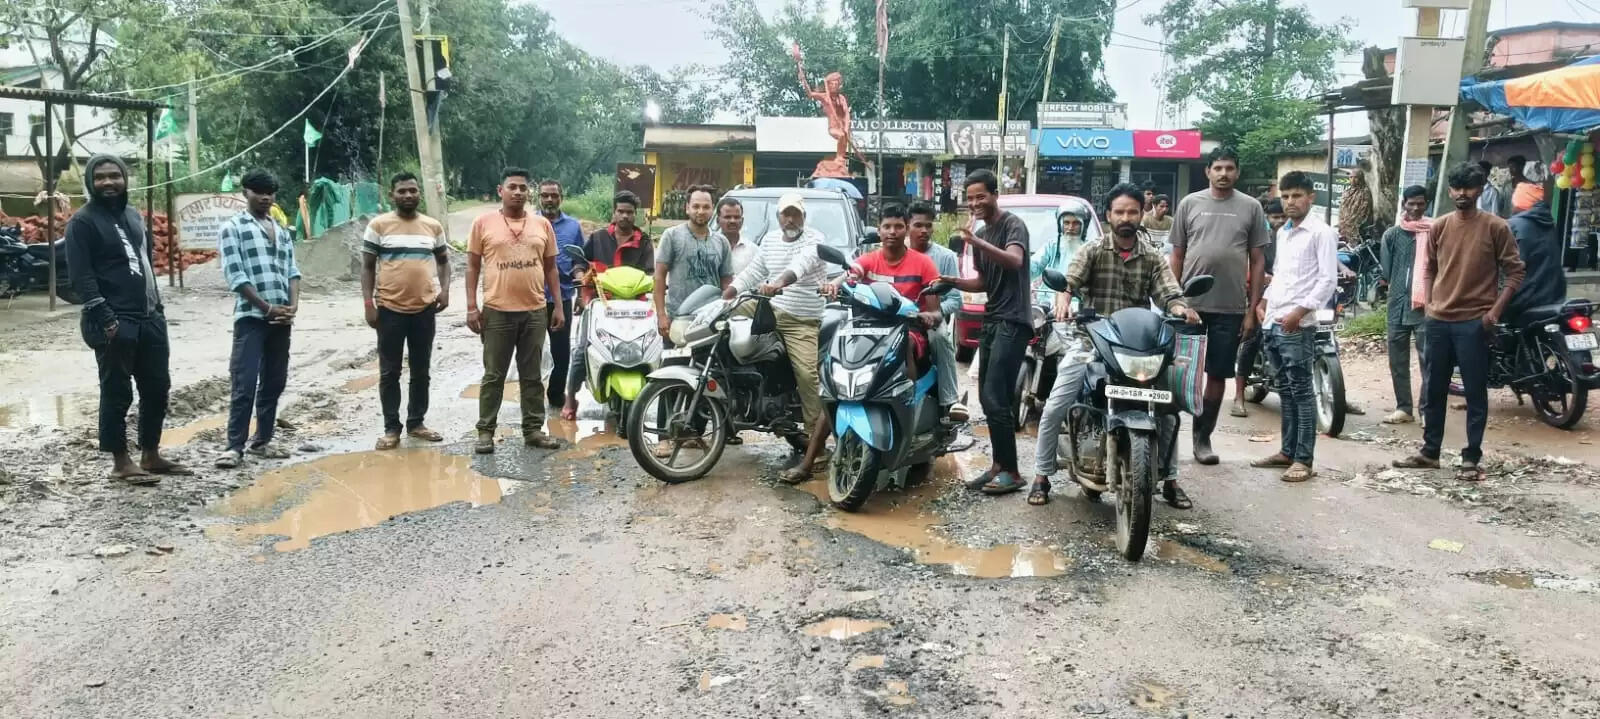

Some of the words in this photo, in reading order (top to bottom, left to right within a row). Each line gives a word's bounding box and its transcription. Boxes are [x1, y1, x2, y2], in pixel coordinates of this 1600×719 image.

[1038, 103, 1078, 111] PERFECT
[1080, 103, 1115, 111] MOBILE
[850, 120, 869, 131] TAJ
[870, 120, 945, 131] COLLECTION
[1055, 133, 1110, 149] vivo
